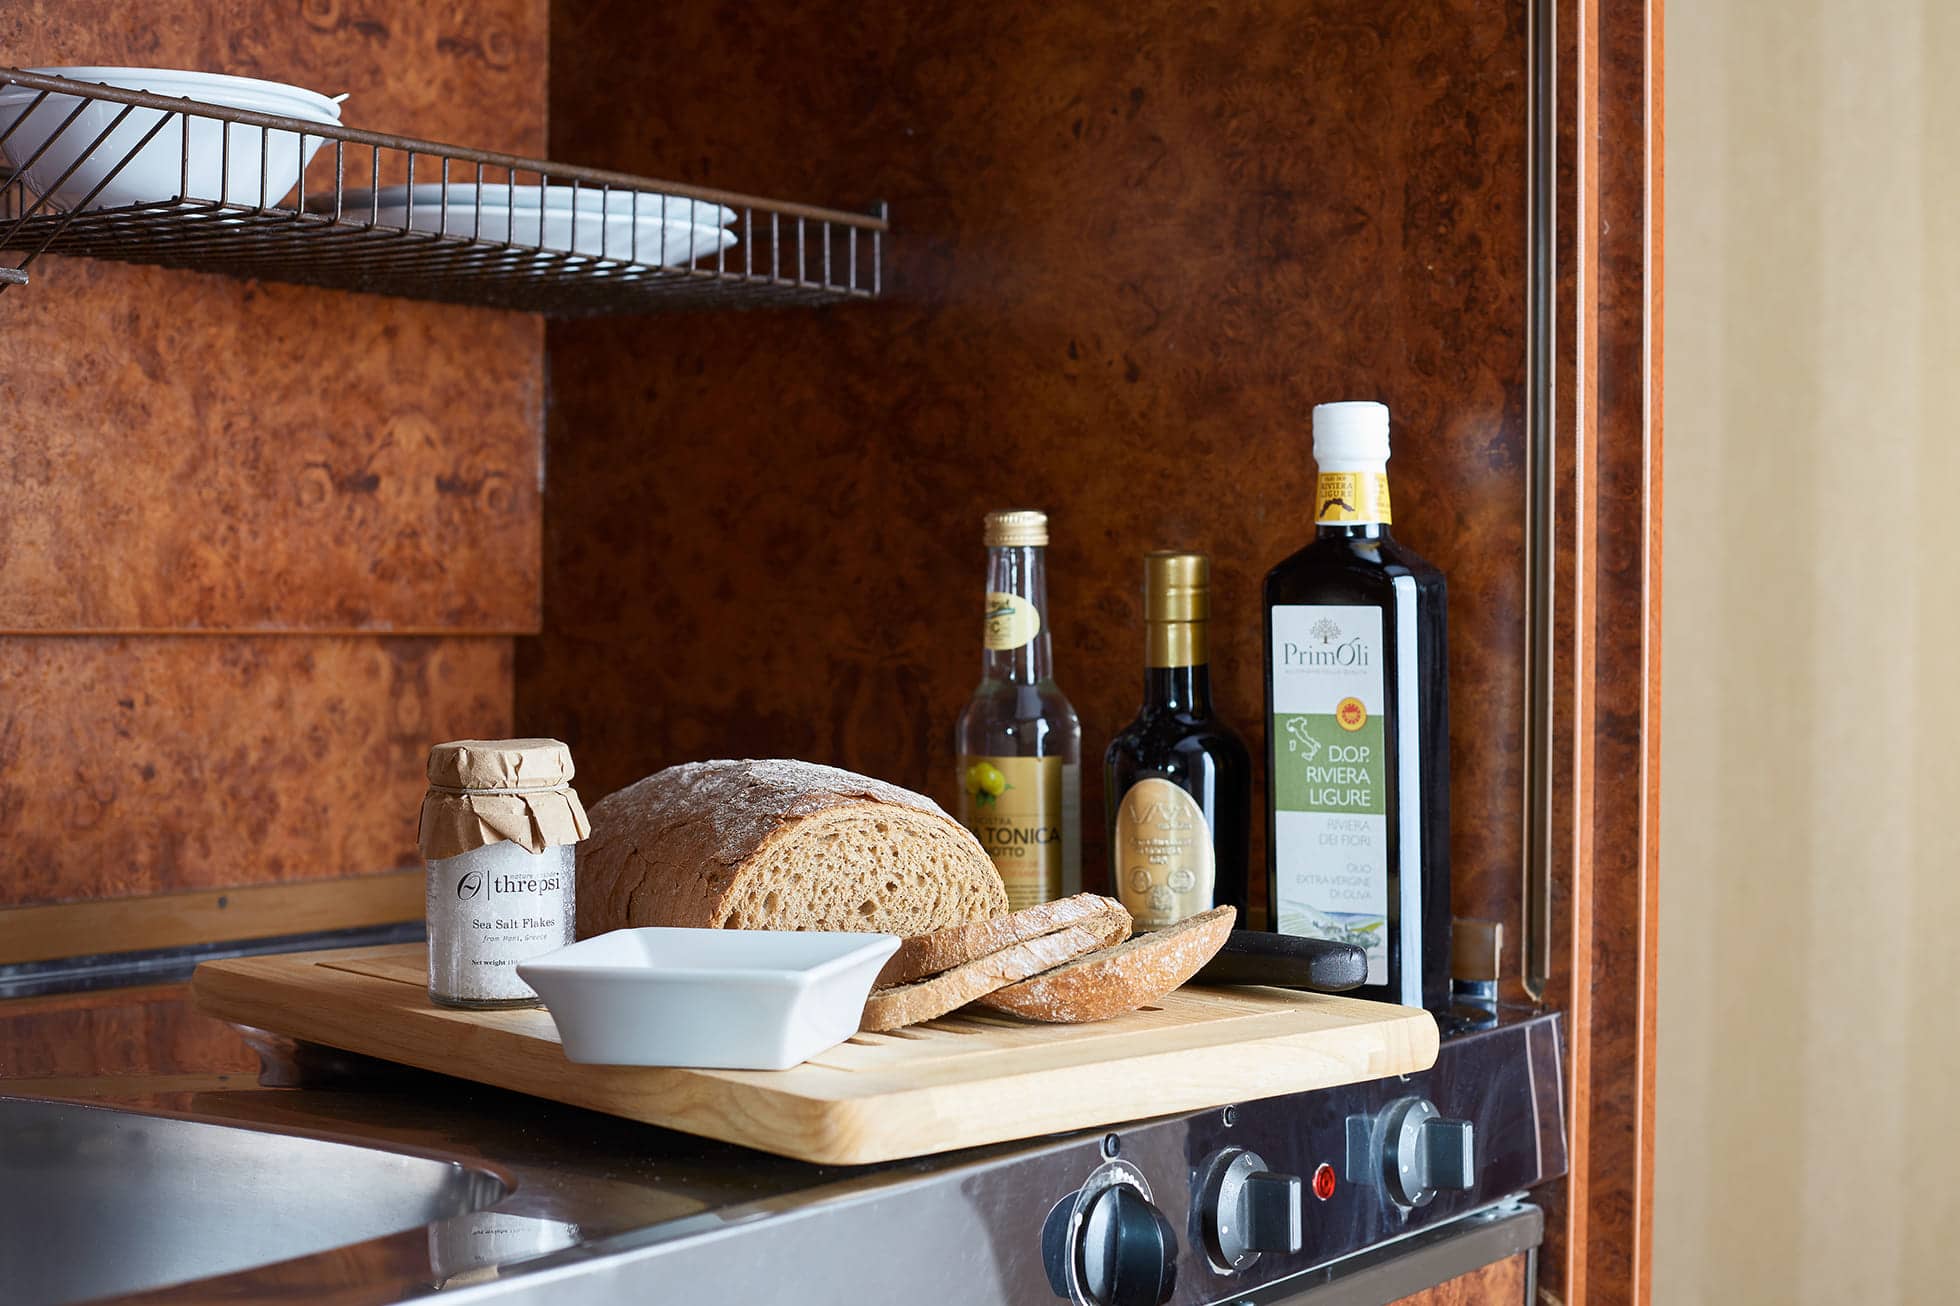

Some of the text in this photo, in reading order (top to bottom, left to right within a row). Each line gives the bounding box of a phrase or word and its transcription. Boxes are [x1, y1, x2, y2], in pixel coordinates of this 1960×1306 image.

[1306, 766, 1371, 784] RIVIERA
[1309, 788, 1371, 806] LIGURE
[1327, 819, 1371, 832] RIVIERA
[984, 827, 1061, 845] TONICA
[494, 872, 560, 896] threpsi
[472, 917, 556, 930] Sea Salt Flakes
[483, 959, 506, 968] weight
